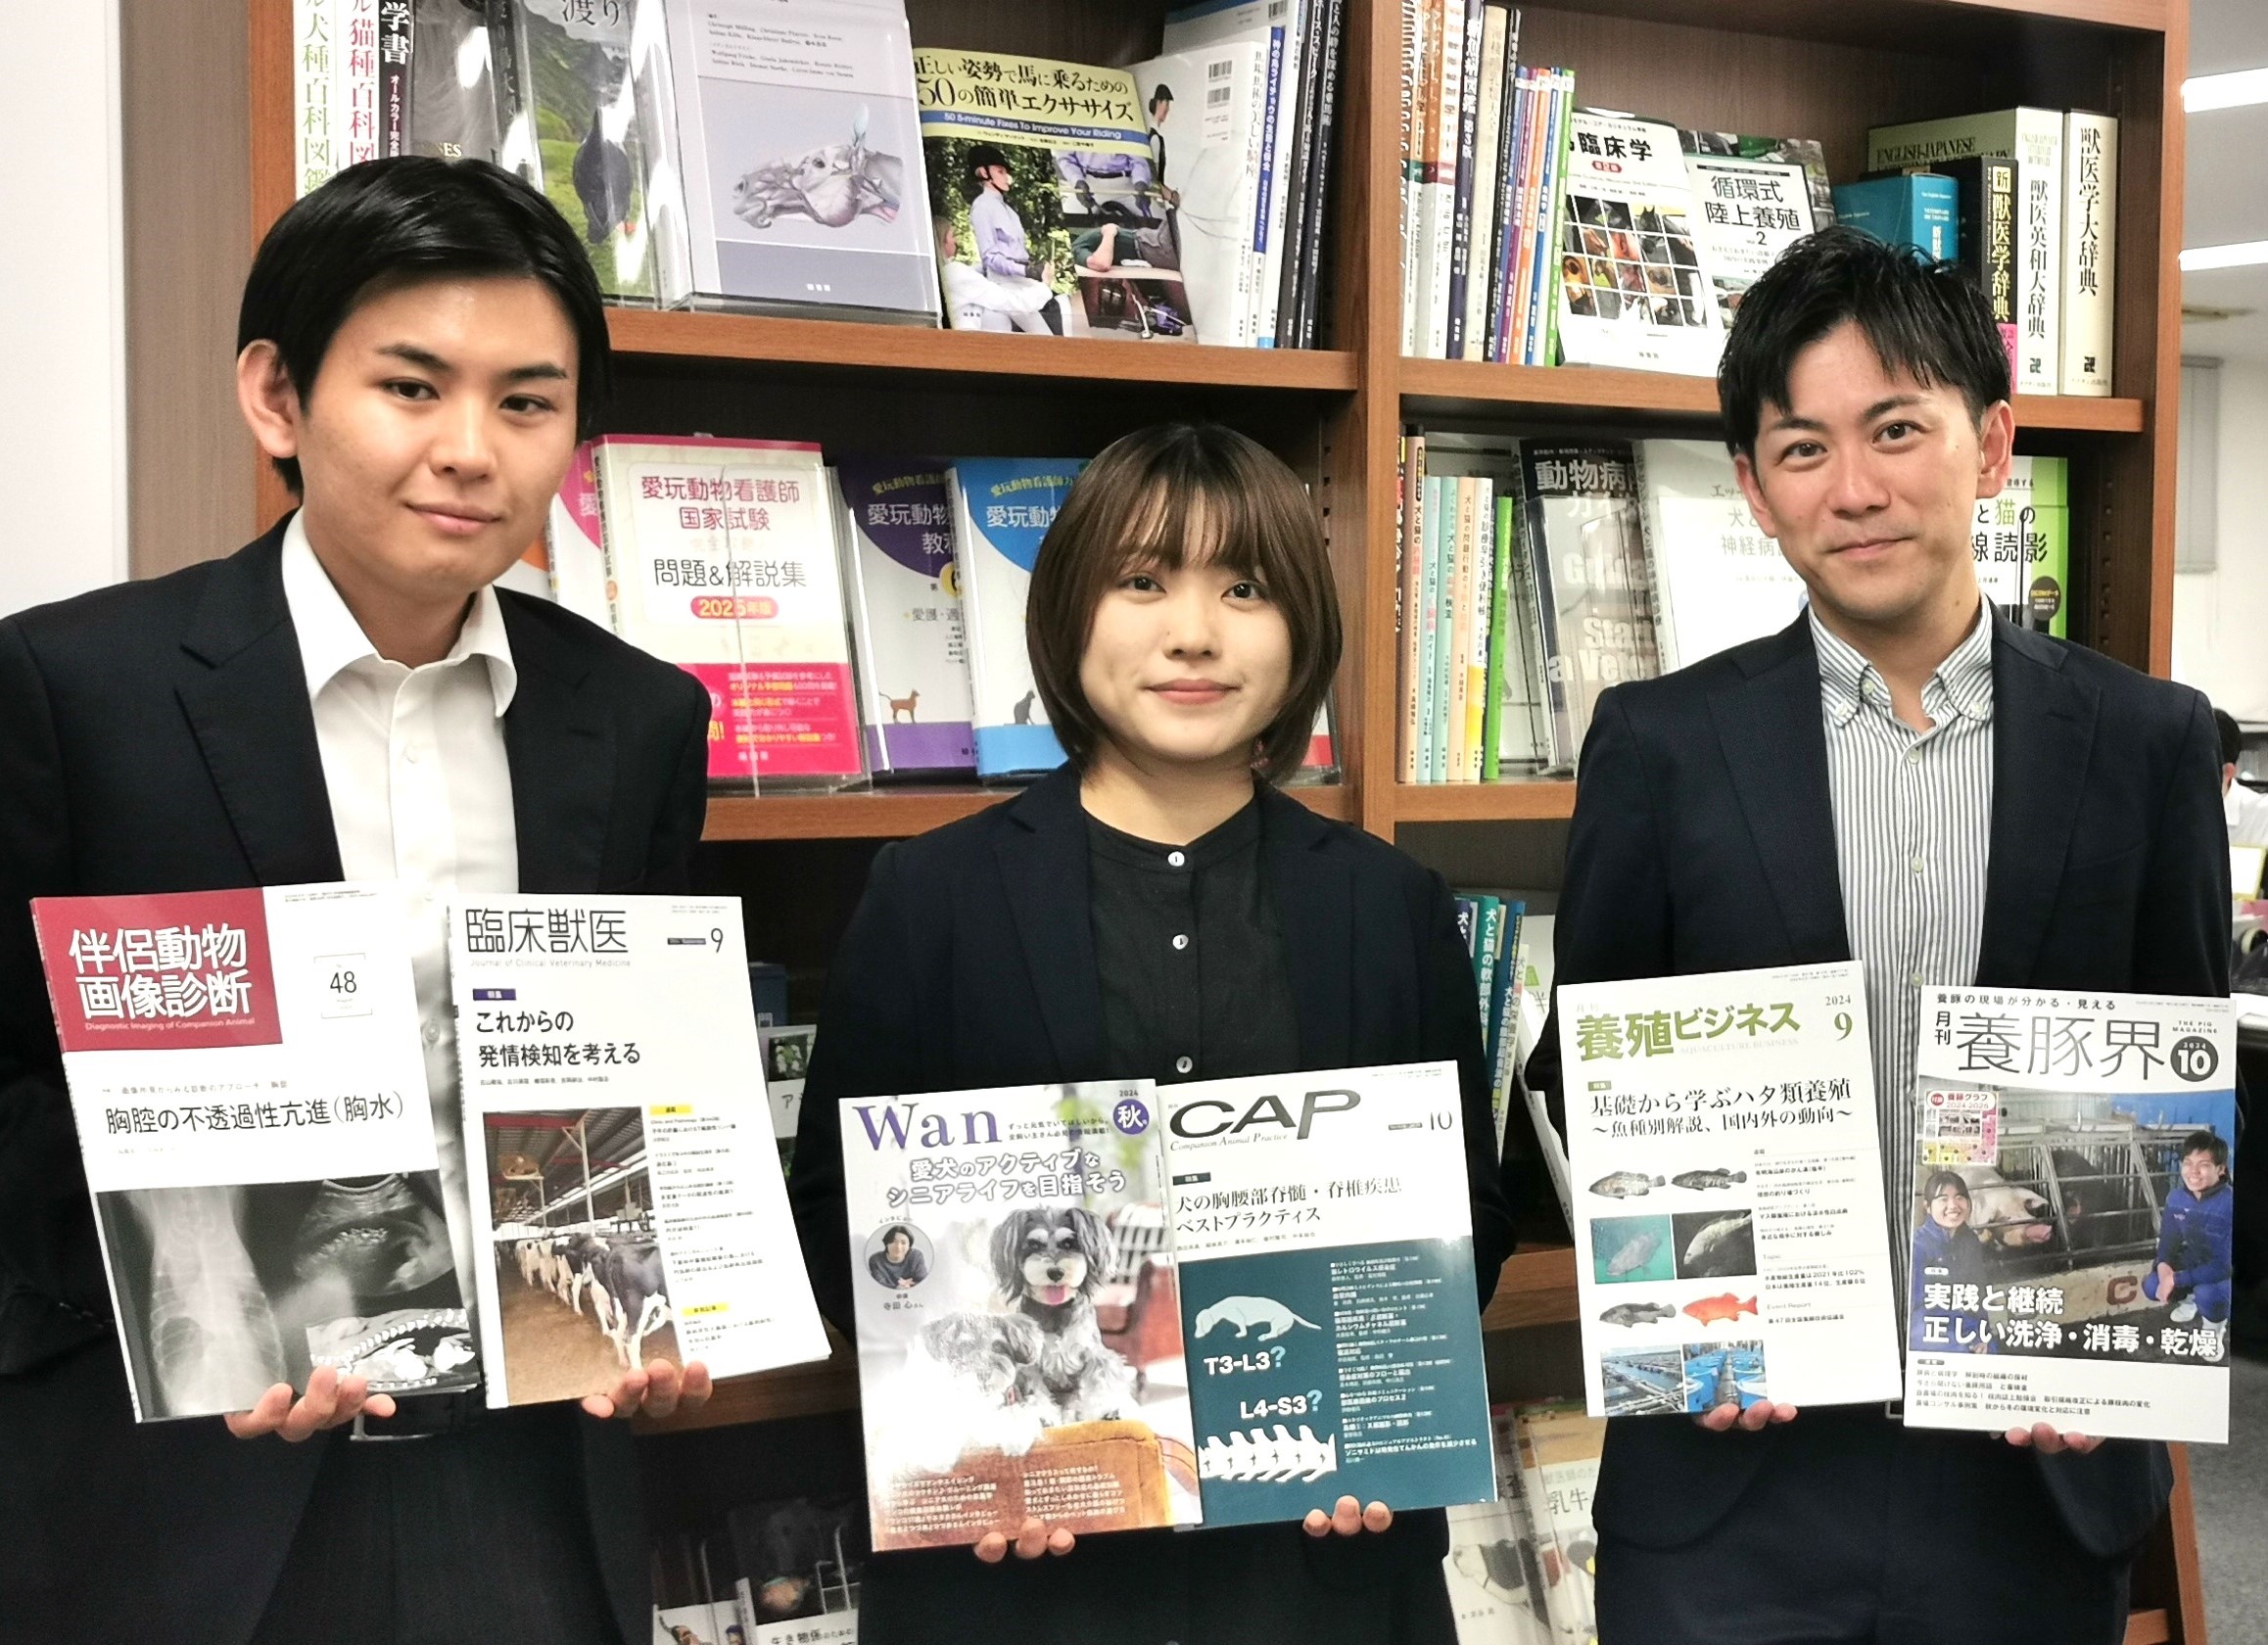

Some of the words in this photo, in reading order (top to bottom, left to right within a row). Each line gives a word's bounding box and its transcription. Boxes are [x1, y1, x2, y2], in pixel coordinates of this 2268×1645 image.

[1570, 131, 1653, 161] 臨床学
[1711, 175, 1783, 203] 循環式
[1704, 201, 1801, 231] 陸上養殖
[2078, 127, 2102, 298] 獣医学大辞典
[641, 475, 800, 504] 愛玩動物看護師
[679, 507, 772, 531] 国家試験
[1977, 498, 2036, 526] と猫の
[654, 558, 807, 588] 問題&解説集
[465, 908, 629, 954] 臨床獣医
[710, 927, 724, 954] 9
[69, 922, 248, 975] 伴侶動物
[470, 958, 502, 967] Journal
[505, 958, 513, 967] of
[515, 958, 546, 967] Clinical
[549, 958, 593, 969] Veterinary
[595, 958, 632, 967] Medicine
[75, 969, 253, 1020] 画像診断
[330, 970, 357, 995] 48
[1825, 995, 1852, 1006] 2024
[1937, 993, 2116, 1010] 養豚の現場が分かる・見える
[85, 1021, 129, 1032] Diagnostic
[130, 1021, 165, 1033] Imaging
[165, 1020, 175, 1030] of
[176, 1019, 224, 1032] Companion
[226, 1016, 256, 1027] Animal
[476, 1010, 574, 1033] これからの
[1576, 1002, 1801, 1062] 養殖ビジネス
[1833, 1011, 1853, 1041] 9
[1935, 1010, 1952, 1046] 月刊
[479, 1042, 641, 1068] 発情検知を考える
[1956, 1011, 2165, 1081] 養豚界
[2177, 1049, 2212, 1075] 10
[1119, 1089, 1139, 1098] 2024
[1590, 1078, 1851, 1117] 基礎から学ぶハタ類養殖
[852, 1103, 1003, 1151] Wan
[1117, 1104, 1142, 1129] 秋
[1169, 1089, 1361, 1141] CAP
[1430, 1111, 1453, 1131] 10
[1219, 1135, 1251, 1147] Animal
[1253, 1132, 1288, 1144] Practice
[910, 1148, 1100, 1182] 愛犬のアクティブな
[886, 1170, 1126, 1207] シニアライフを目指そう
[1176, 1177, 1402, 1214] 犬の胸腰部脊髄・脊椎疾患
[1177, 1206, 1322, 1234] ベストプラクティス
[1923, 1282, 2064, 1315] 実践と継続
[1922, 1316, 2222, 1357] 正しい洗浄・消毒・乾燥
[1204, 1345, 1286, 1376] T3-L3?
[1240, 1388, 1323, 1420] L4-S3?
